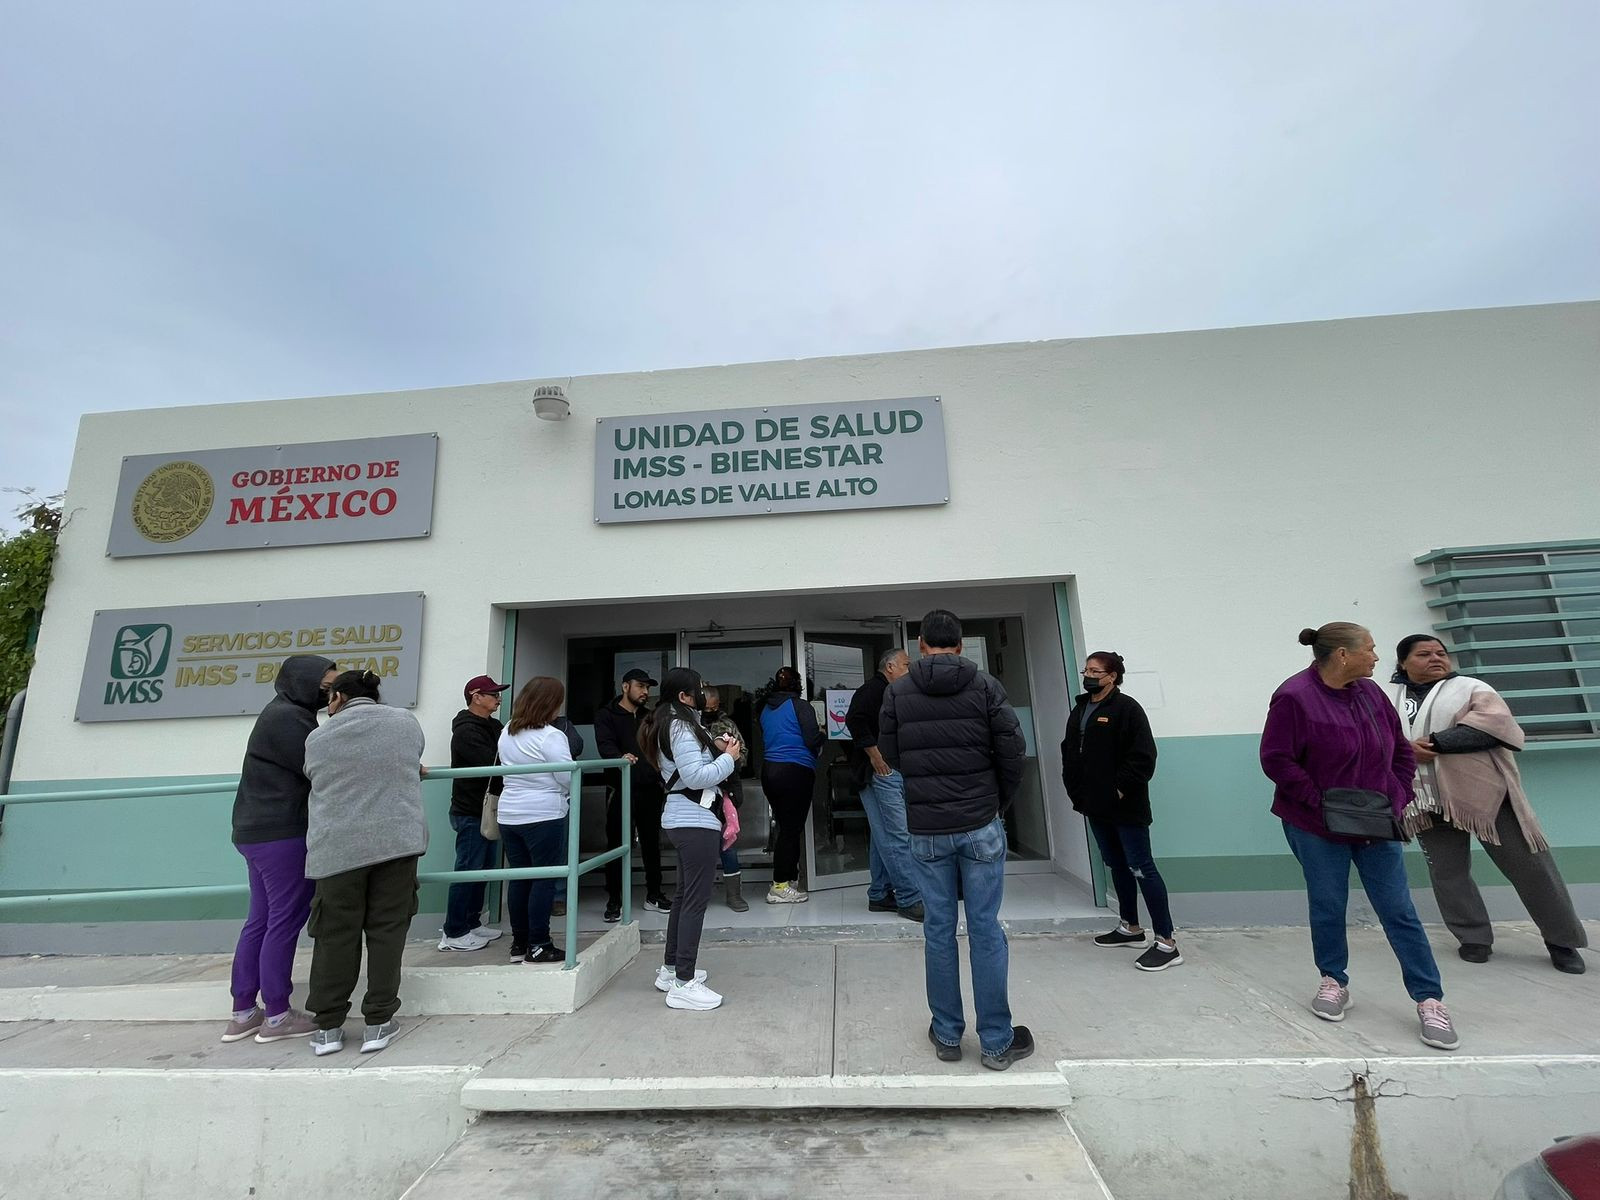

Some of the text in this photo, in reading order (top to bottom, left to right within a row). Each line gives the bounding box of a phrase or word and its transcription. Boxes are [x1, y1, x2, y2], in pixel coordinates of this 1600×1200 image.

[614, 409, 924, 452] UNIDAD DE SALUD
[231, 460, 401, 489] GOBIERNO DE
[613, 454, 686, 480] IMSS
[711, 442, 884, 475] BIENESTAR
[158, 463, 185, 475] UNIDOS
[187, 463, 212, 496] MEXICANOS
[613, 476, 878, 510] LOMAS DE VALLE ALTO
[225, 486, 398, 526] MÉXICO
[182, 624, 403, 653] SERVICIOS DE SALUD
[175, 664, 239, 688] IMSS
[255, 655, 400, 683] BISTAR
[103, 679, 164, 705] IMSS
